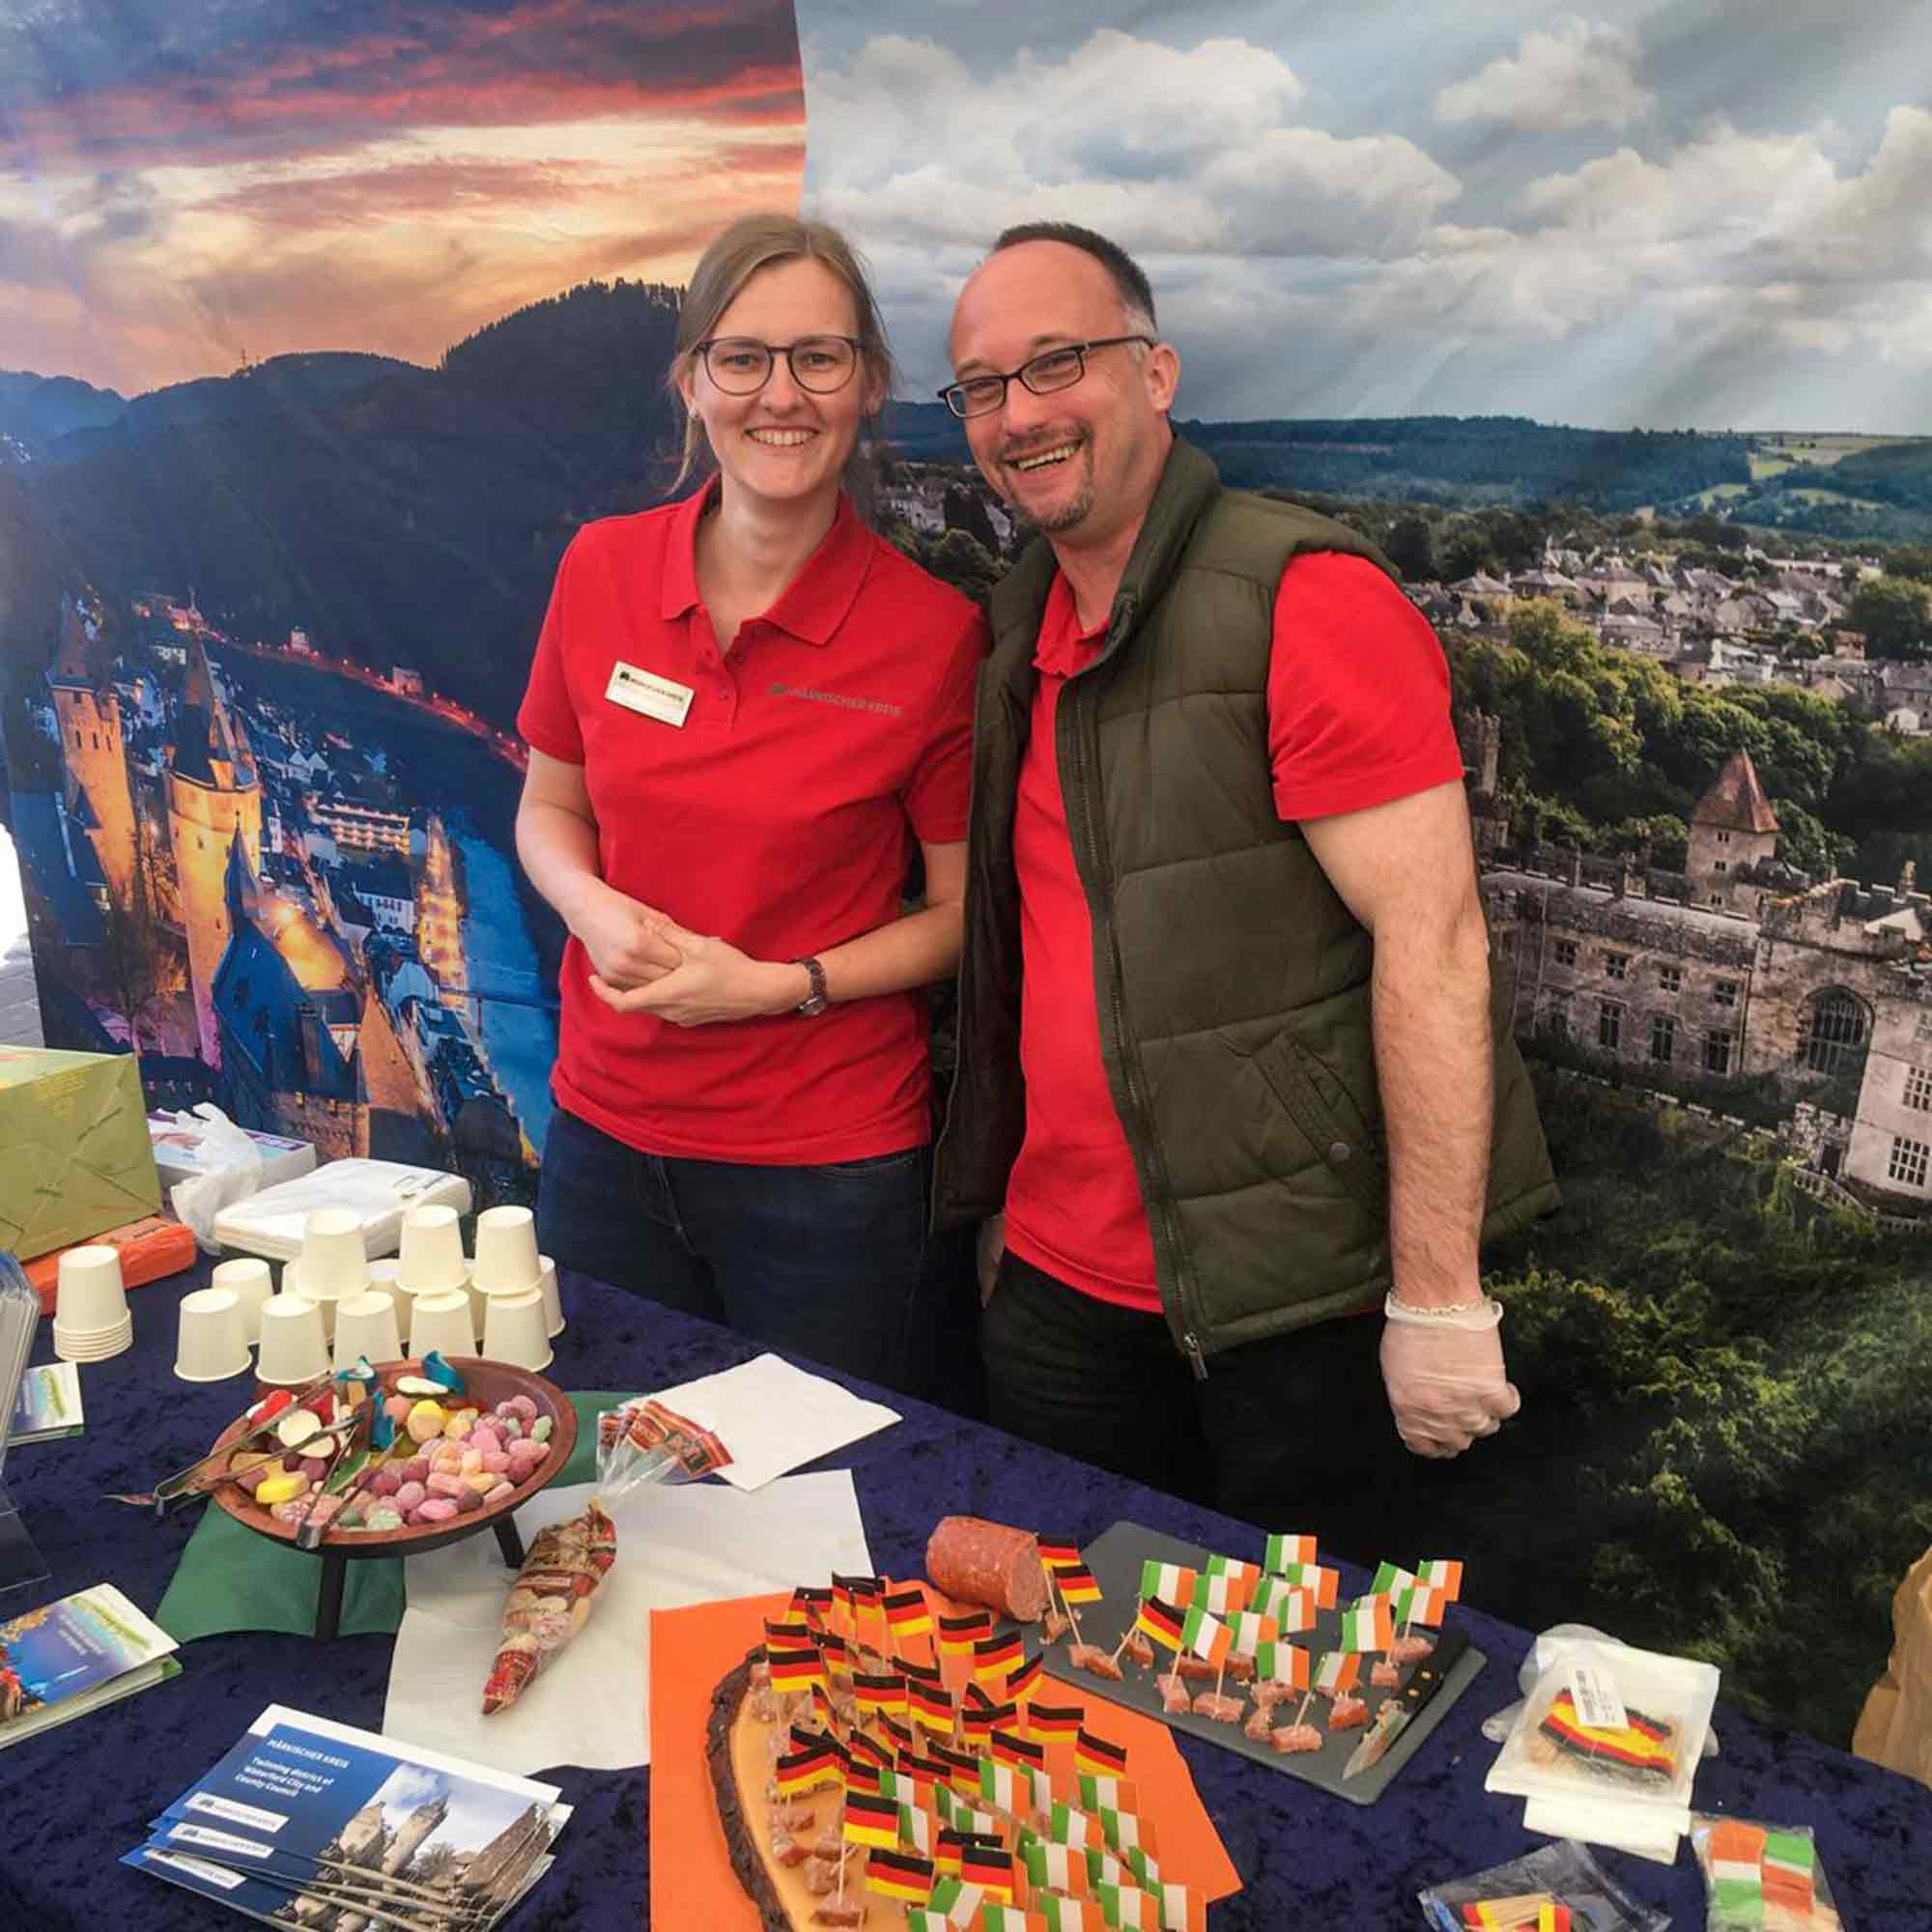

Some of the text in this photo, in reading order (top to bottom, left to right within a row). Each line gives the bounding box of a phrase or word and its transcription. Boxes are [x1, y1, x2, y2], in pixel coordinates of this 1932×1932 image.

[252, 1756, 335, 1786] Twinning district of
[235, 1774, 300, 1798] County Council
[287, 1776, 304, 1789] City
[303, 1783, 323, 1794] and
